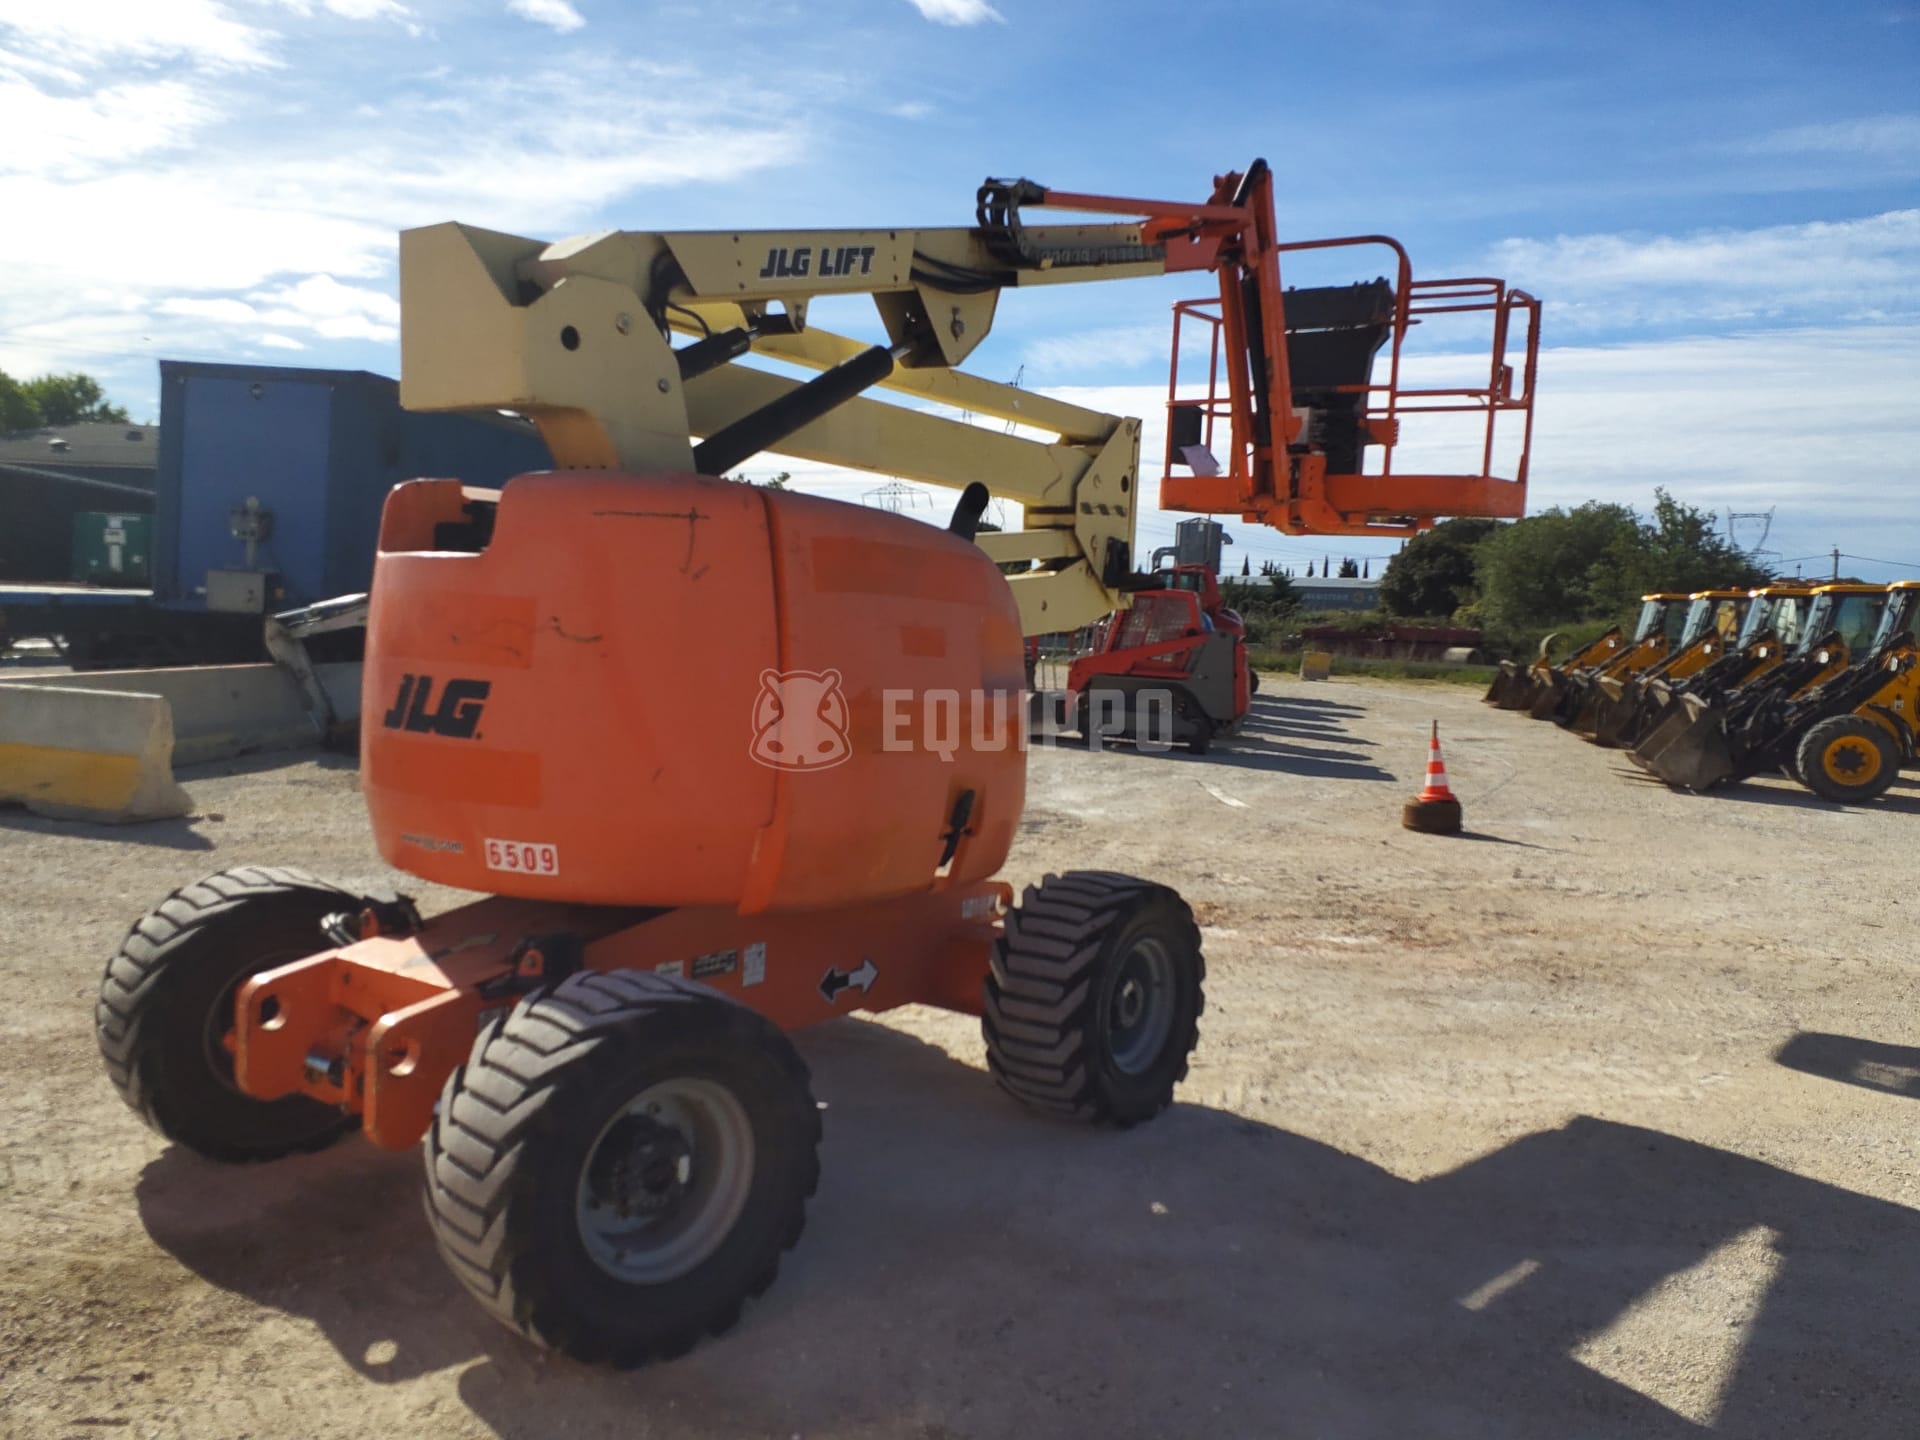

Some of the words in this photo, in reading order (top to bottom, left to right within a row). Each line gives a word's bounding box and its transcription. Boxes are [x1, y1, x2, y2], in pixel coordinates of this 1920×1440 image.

[759, 247, 811, 278] JLG
[818, 246, 875, 277] LIFT
[383, 673, 491, 739] JLG
[489, 842, 554, 872] 6509
